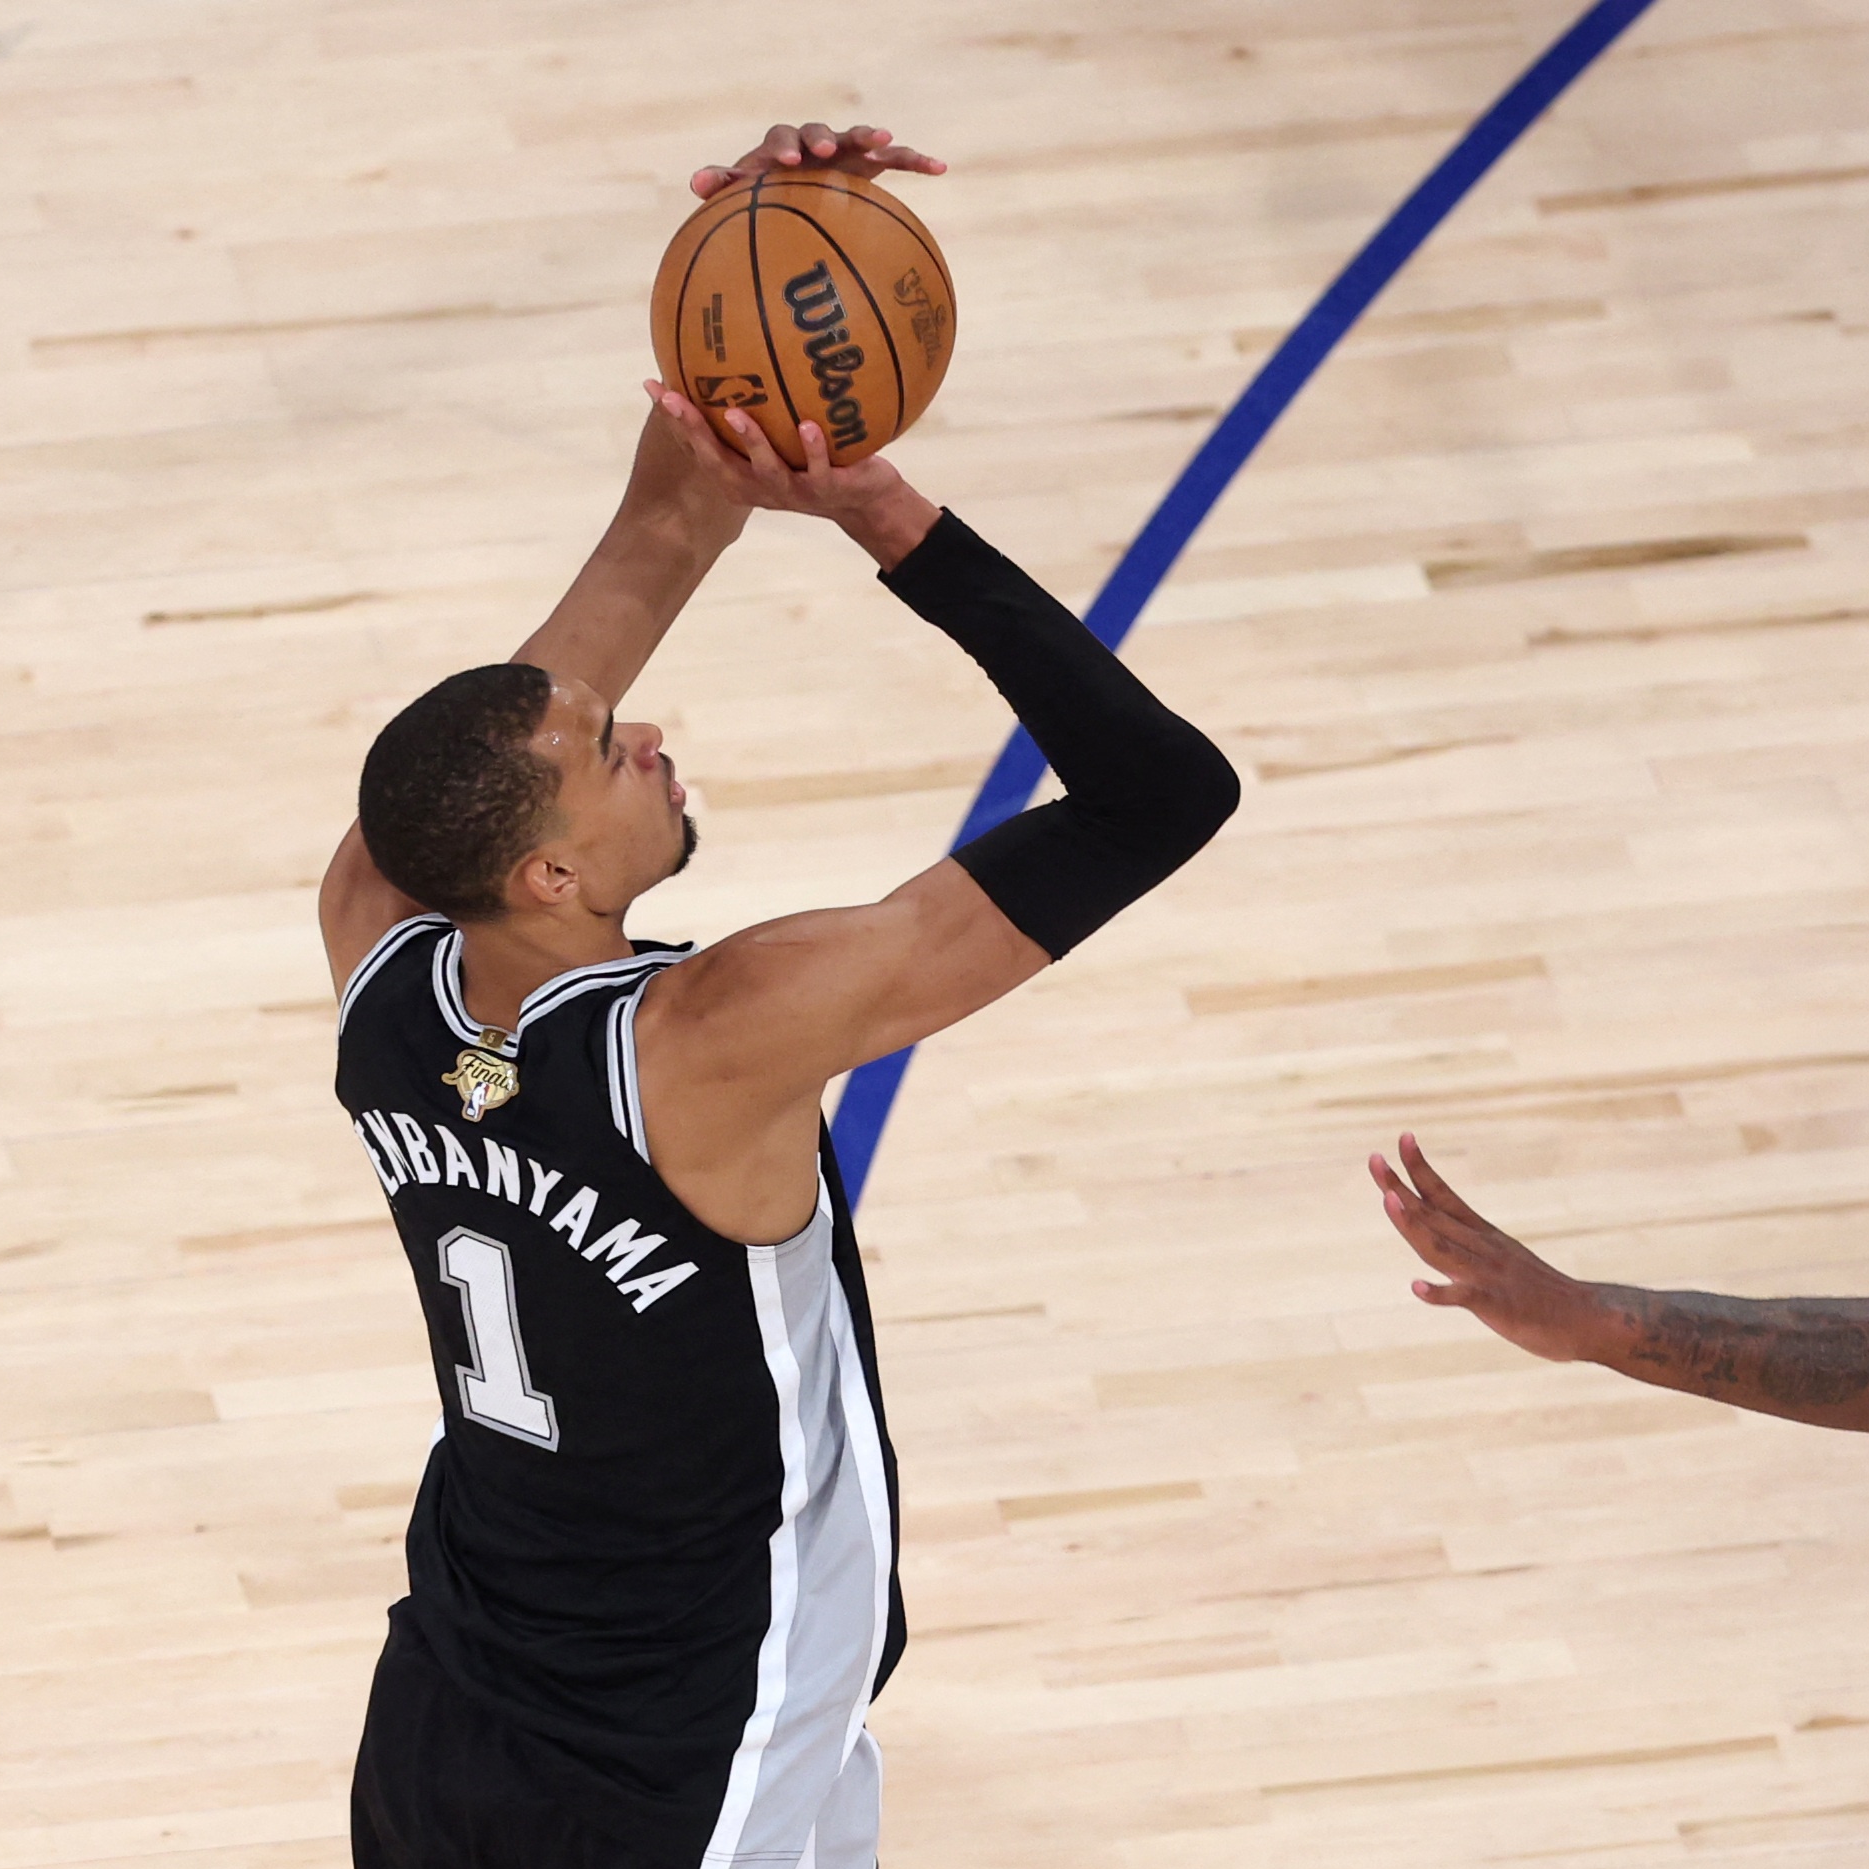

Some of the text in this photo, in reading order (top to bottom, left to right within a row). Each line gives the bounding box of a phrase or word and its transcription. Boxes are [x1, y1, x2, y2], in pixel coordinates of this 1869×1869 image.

[782, 258, 869, 451] Wilson
[353, 1108, 701, 1315] EMBANYAMA
[436, 1224, 561, 1453] 1
